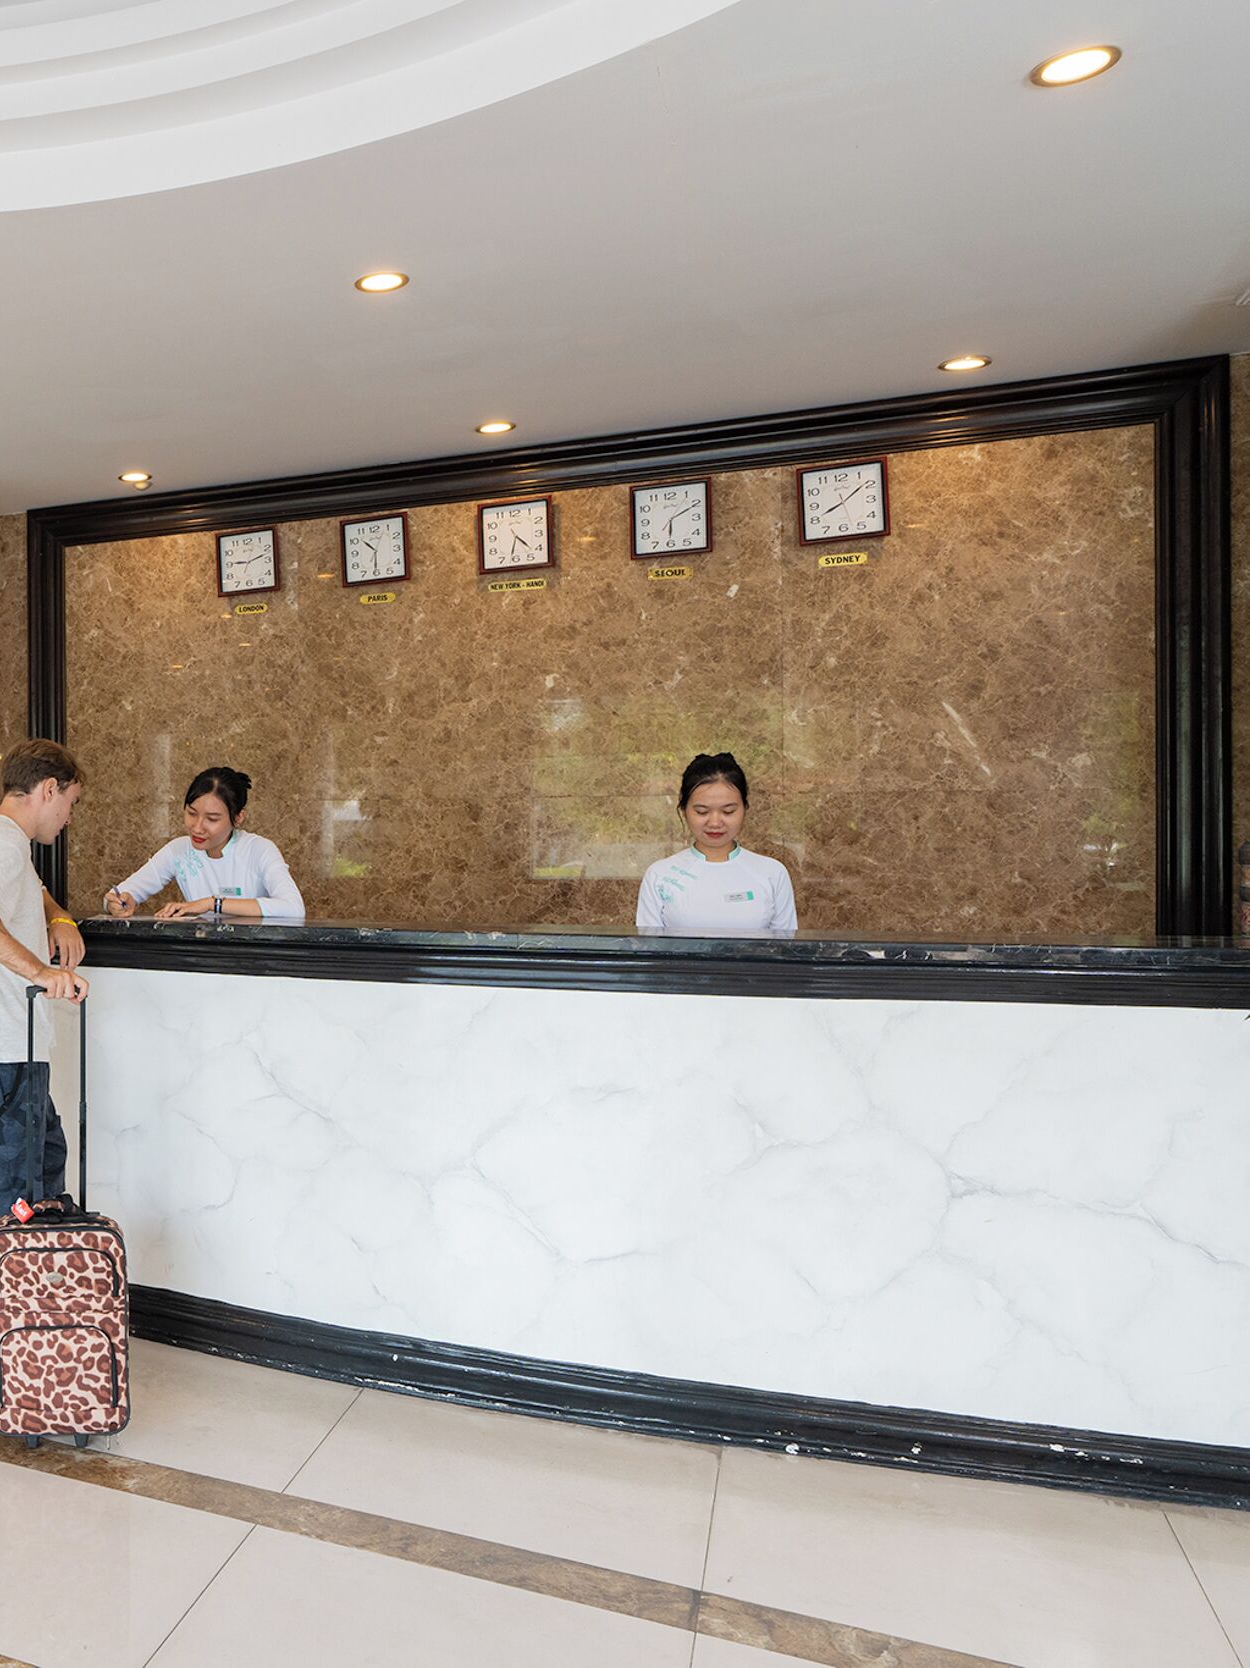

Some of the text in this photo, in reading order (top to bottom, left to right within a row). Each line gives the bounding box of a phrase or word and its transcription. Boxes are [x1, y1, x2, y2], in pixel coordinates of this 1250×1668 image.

[835, 473, 848, 482] 12
[865, 480, 875, 489] 2
[664, 492, 676, 500] 12
[808, 488, 820, 496] 10
[692, 499, 701, 507] 2
[866, 495, 876, 503] 3
[640, 505, 651, 513] 10
[809, 502, 819, 510] 9
[534, 516, 543, 524] 2
[692, 513, 701, 521] 3
[810, 516, 820, 524] 8
[369, 525, 380, 533] 12
[822, 526, 830, 534] 7
[838, 524, 849, 532] 6
[857, 522, 866, 530] 5
[641, 532, 650, 540] 8
[692, 528, 700, 536] 4
[652, 541, 659, 549] 7
[683, 538, 692, 546] 5
[527, 553, 534, 561] 5
[825, 555, 860, 564] SYDNEY
[654, 569, 686, 577] SEOUL
[367, 594, 388, 602] PARIS
[239, 604, 264, 612] LONDON
